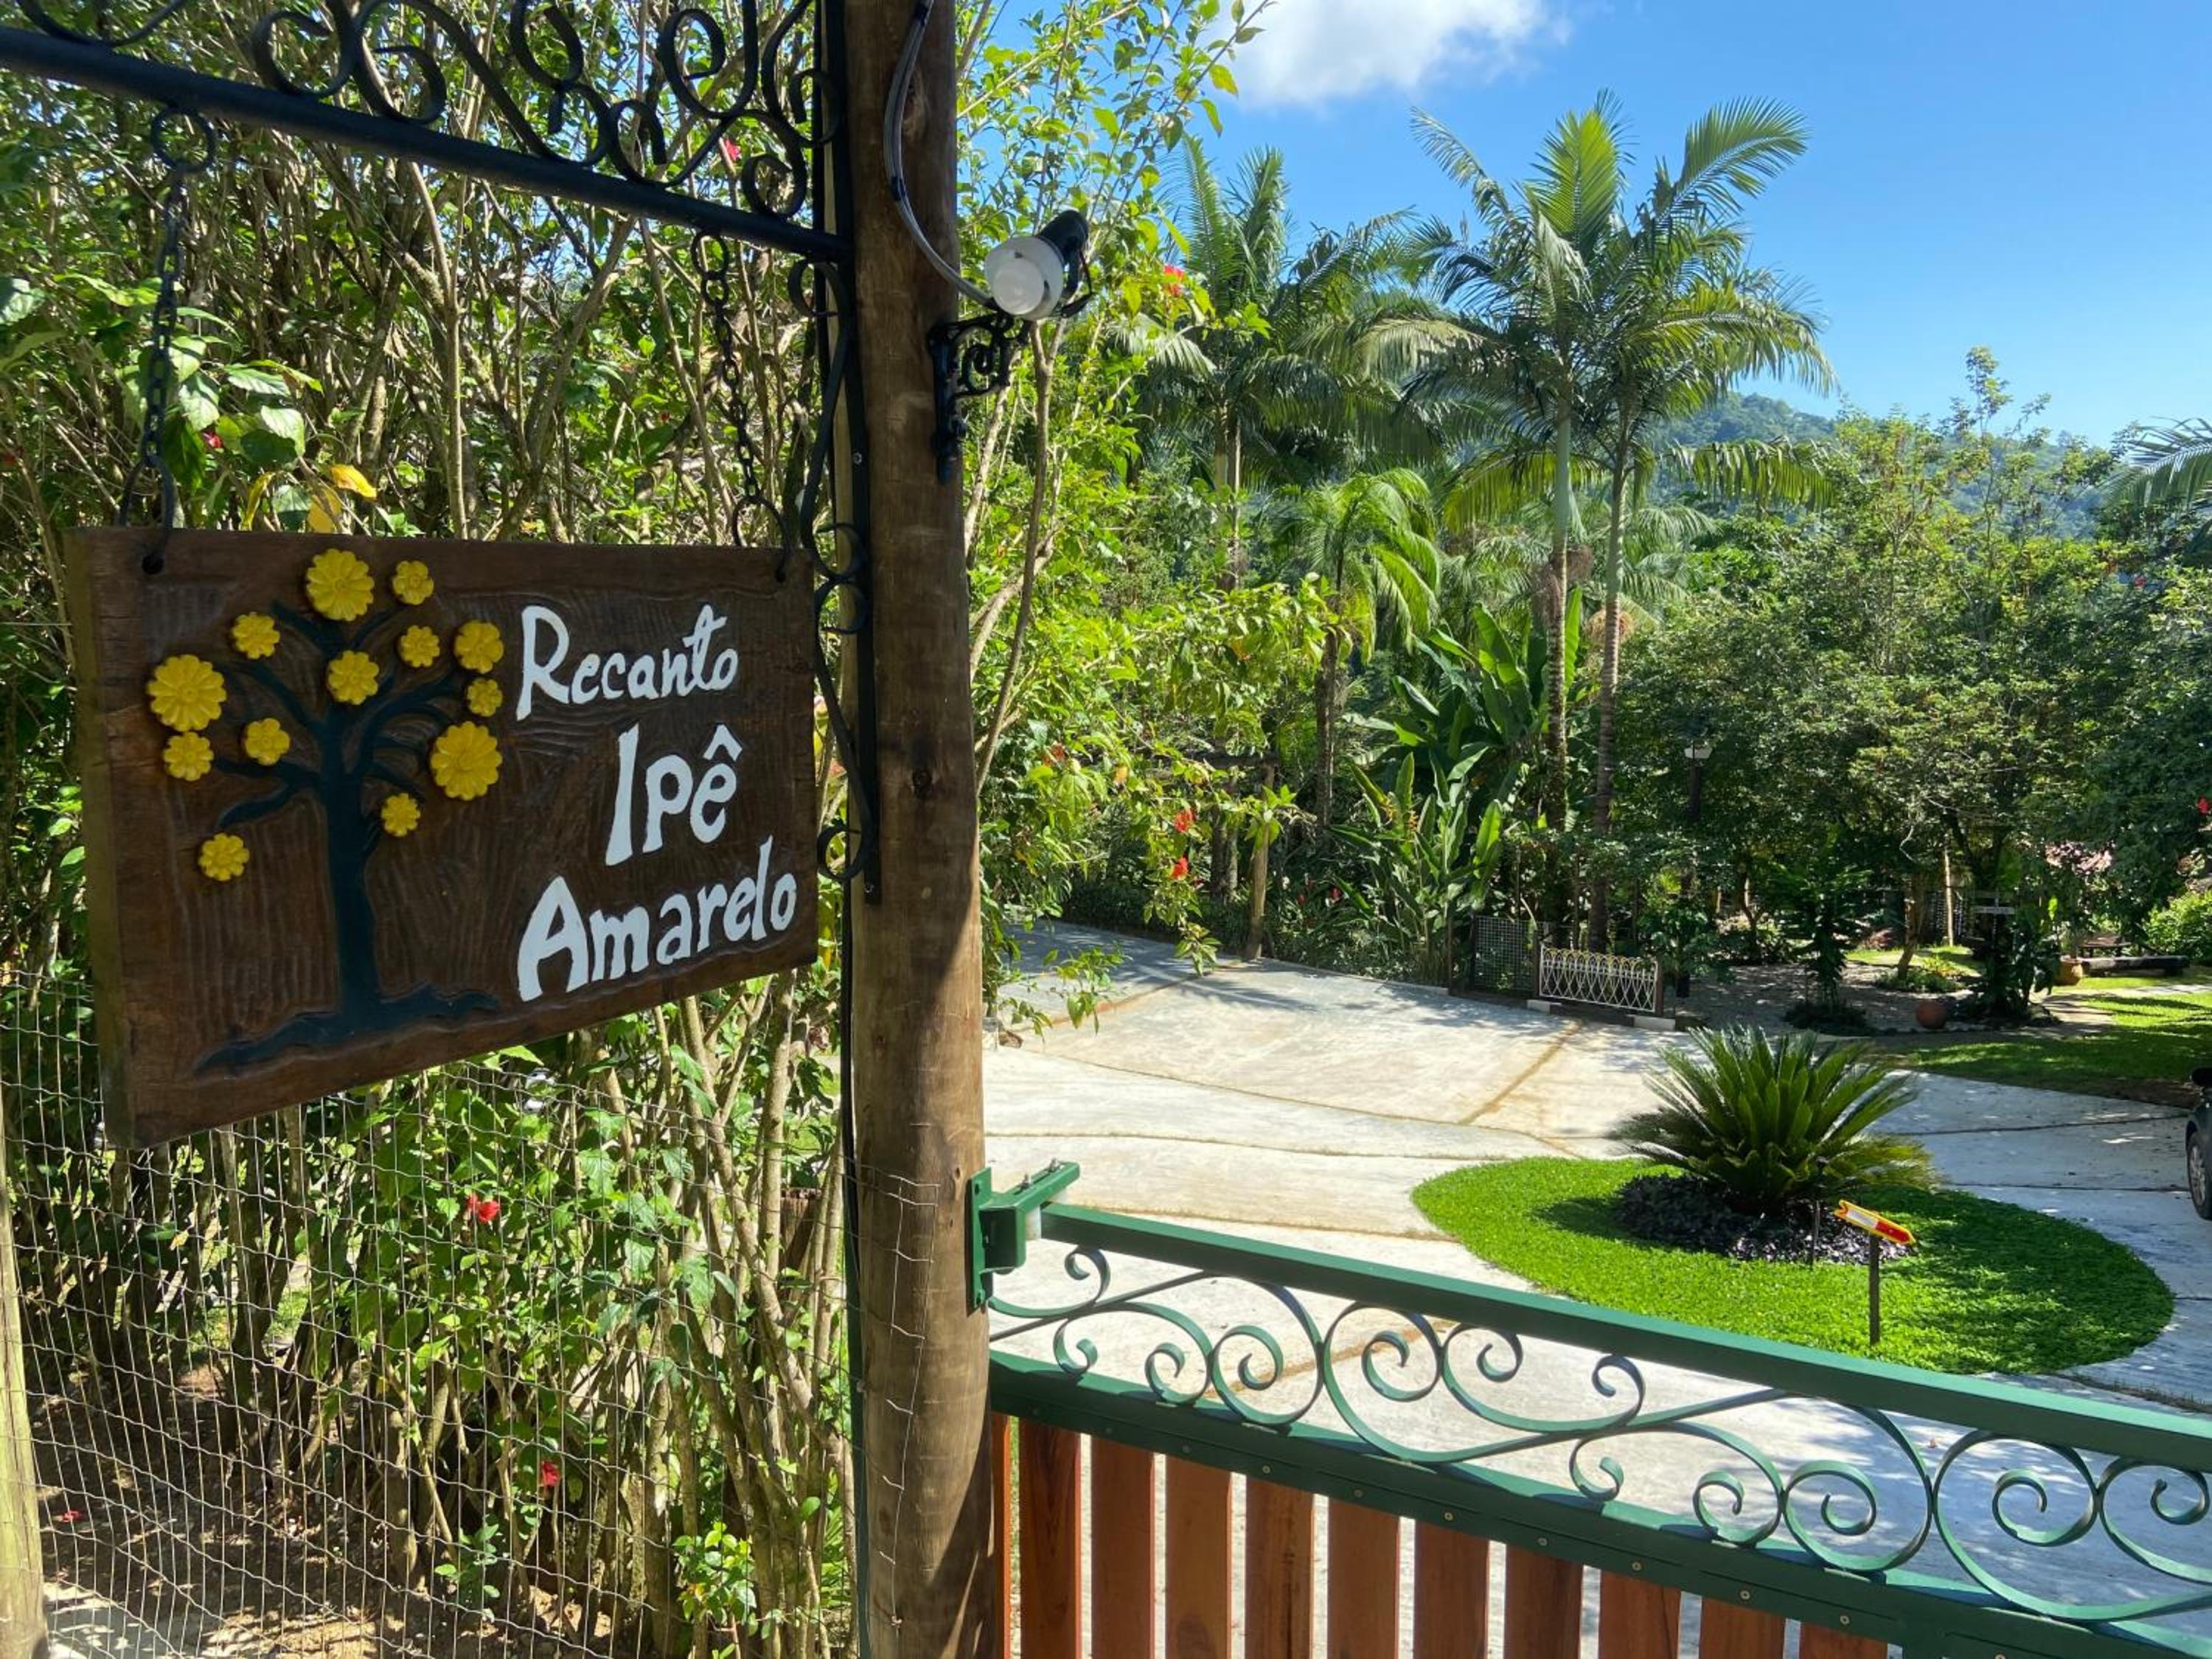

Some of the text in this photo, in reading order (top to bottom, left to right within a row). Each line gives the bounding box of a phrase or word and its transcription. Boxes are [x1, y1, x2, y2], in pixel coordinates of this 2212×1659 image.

[516, 605, 739, 721] Recanto
[605, 723, 743, 866] Ipê
[517, 835, 797, 1002] Amarelo
